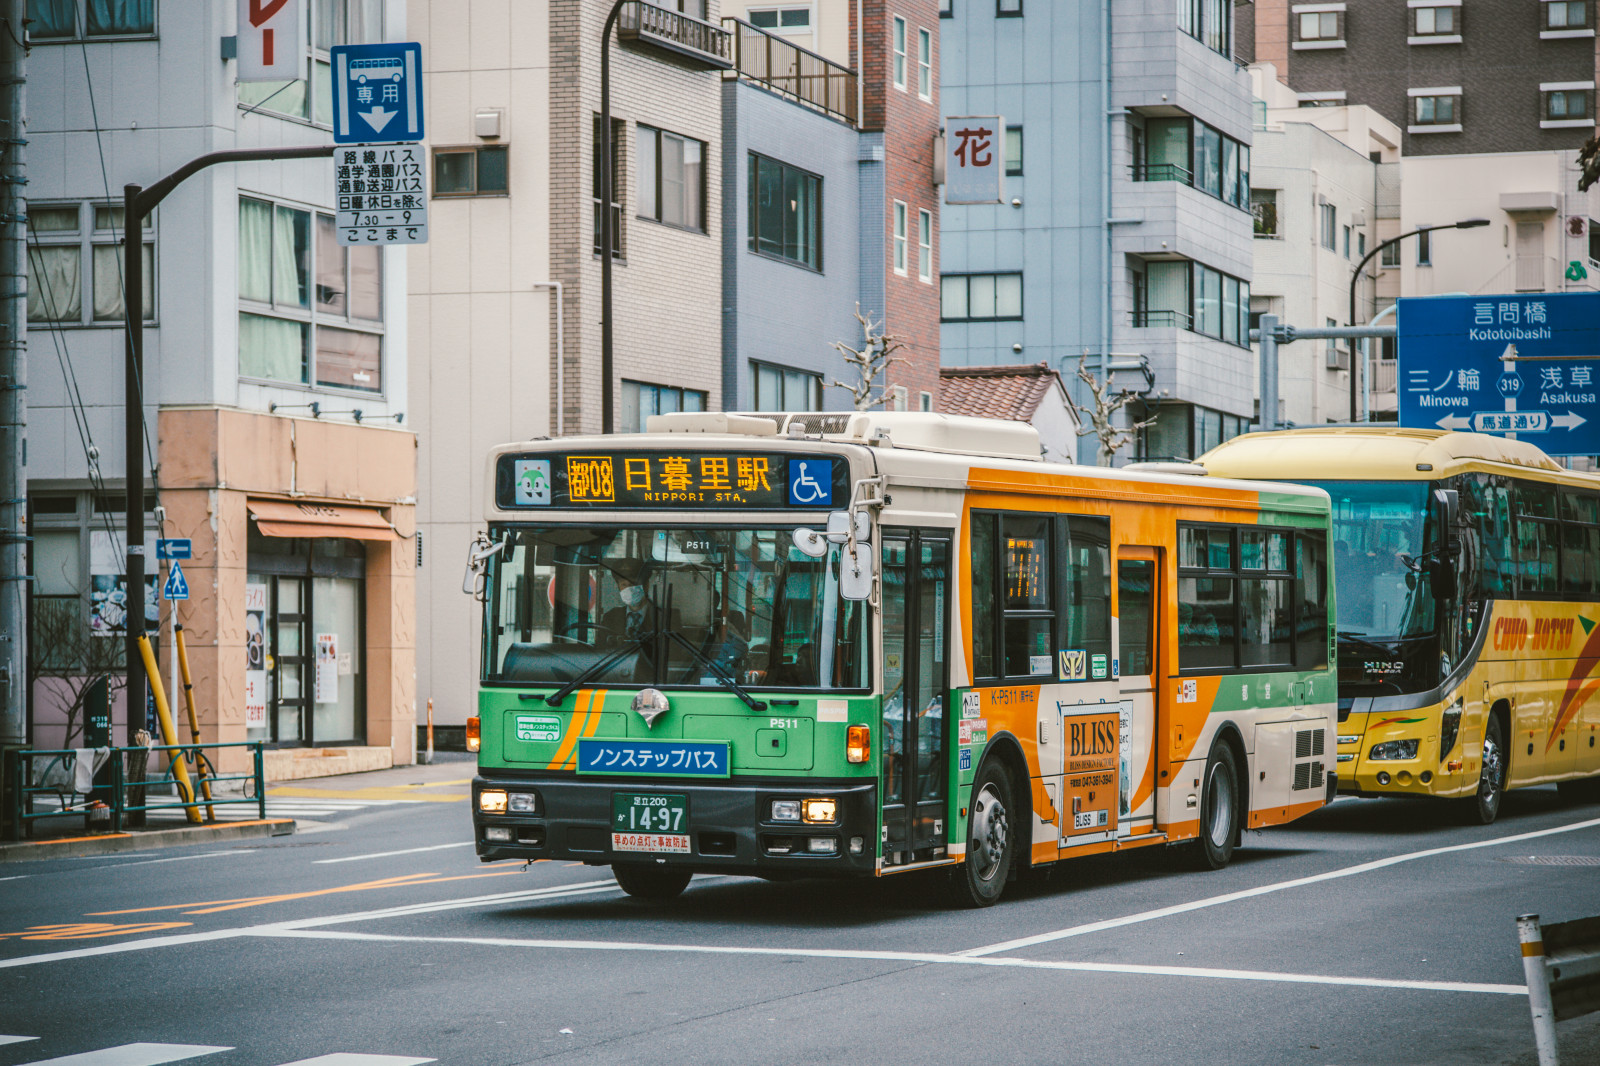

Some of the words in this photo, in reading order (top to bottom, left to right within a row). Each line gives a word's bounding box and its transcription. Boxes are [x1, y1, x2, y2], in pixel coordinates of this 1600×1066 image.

[356, 84, 399, 104] 専用
[954, 127, 993, 168] 花
[344, 150, 415, 165] 路線バス
[338, 178, 422, 193] 通勤送迎バス
[347, 227, 418, 242] ここまで
[1473, 301, 1547, 324] 言問橋
[1469, 326, 1551, 340] Kototoibashi
[1408, 368, 1480, 391] 三ノ輪
[1501, 378, 1520, 391] 319
[1540, 365, 1593, 389] 浅草
[1419, 394, 1469, 407] Minowa
[1540, 392, 1596, 404] Asakusa
[1482, 415, 1541, 430] 馬道通り
[570, 460, 612, 498] 都08
[624, 457, 771, 492] 日暮里駅
[644, 492, 704, 502] NIPPORI
[715, 492, 747, 503] STA.
[686, 541, 710, 549] P511
[1493, 616, 1528, 651] CHUO
[1363, 661, 1404, 669] HINO
[770, 718, 798, 729] P511
[1069, 720, 1115, 757] BLISS
[589, 748, 718, 770] ノンステップバス
[630, 806, 684, 831] 14-97
[1075, 814, 1092, 827] BLISS
[614, 834, 688, 848] 早めの点灯で事故防止
